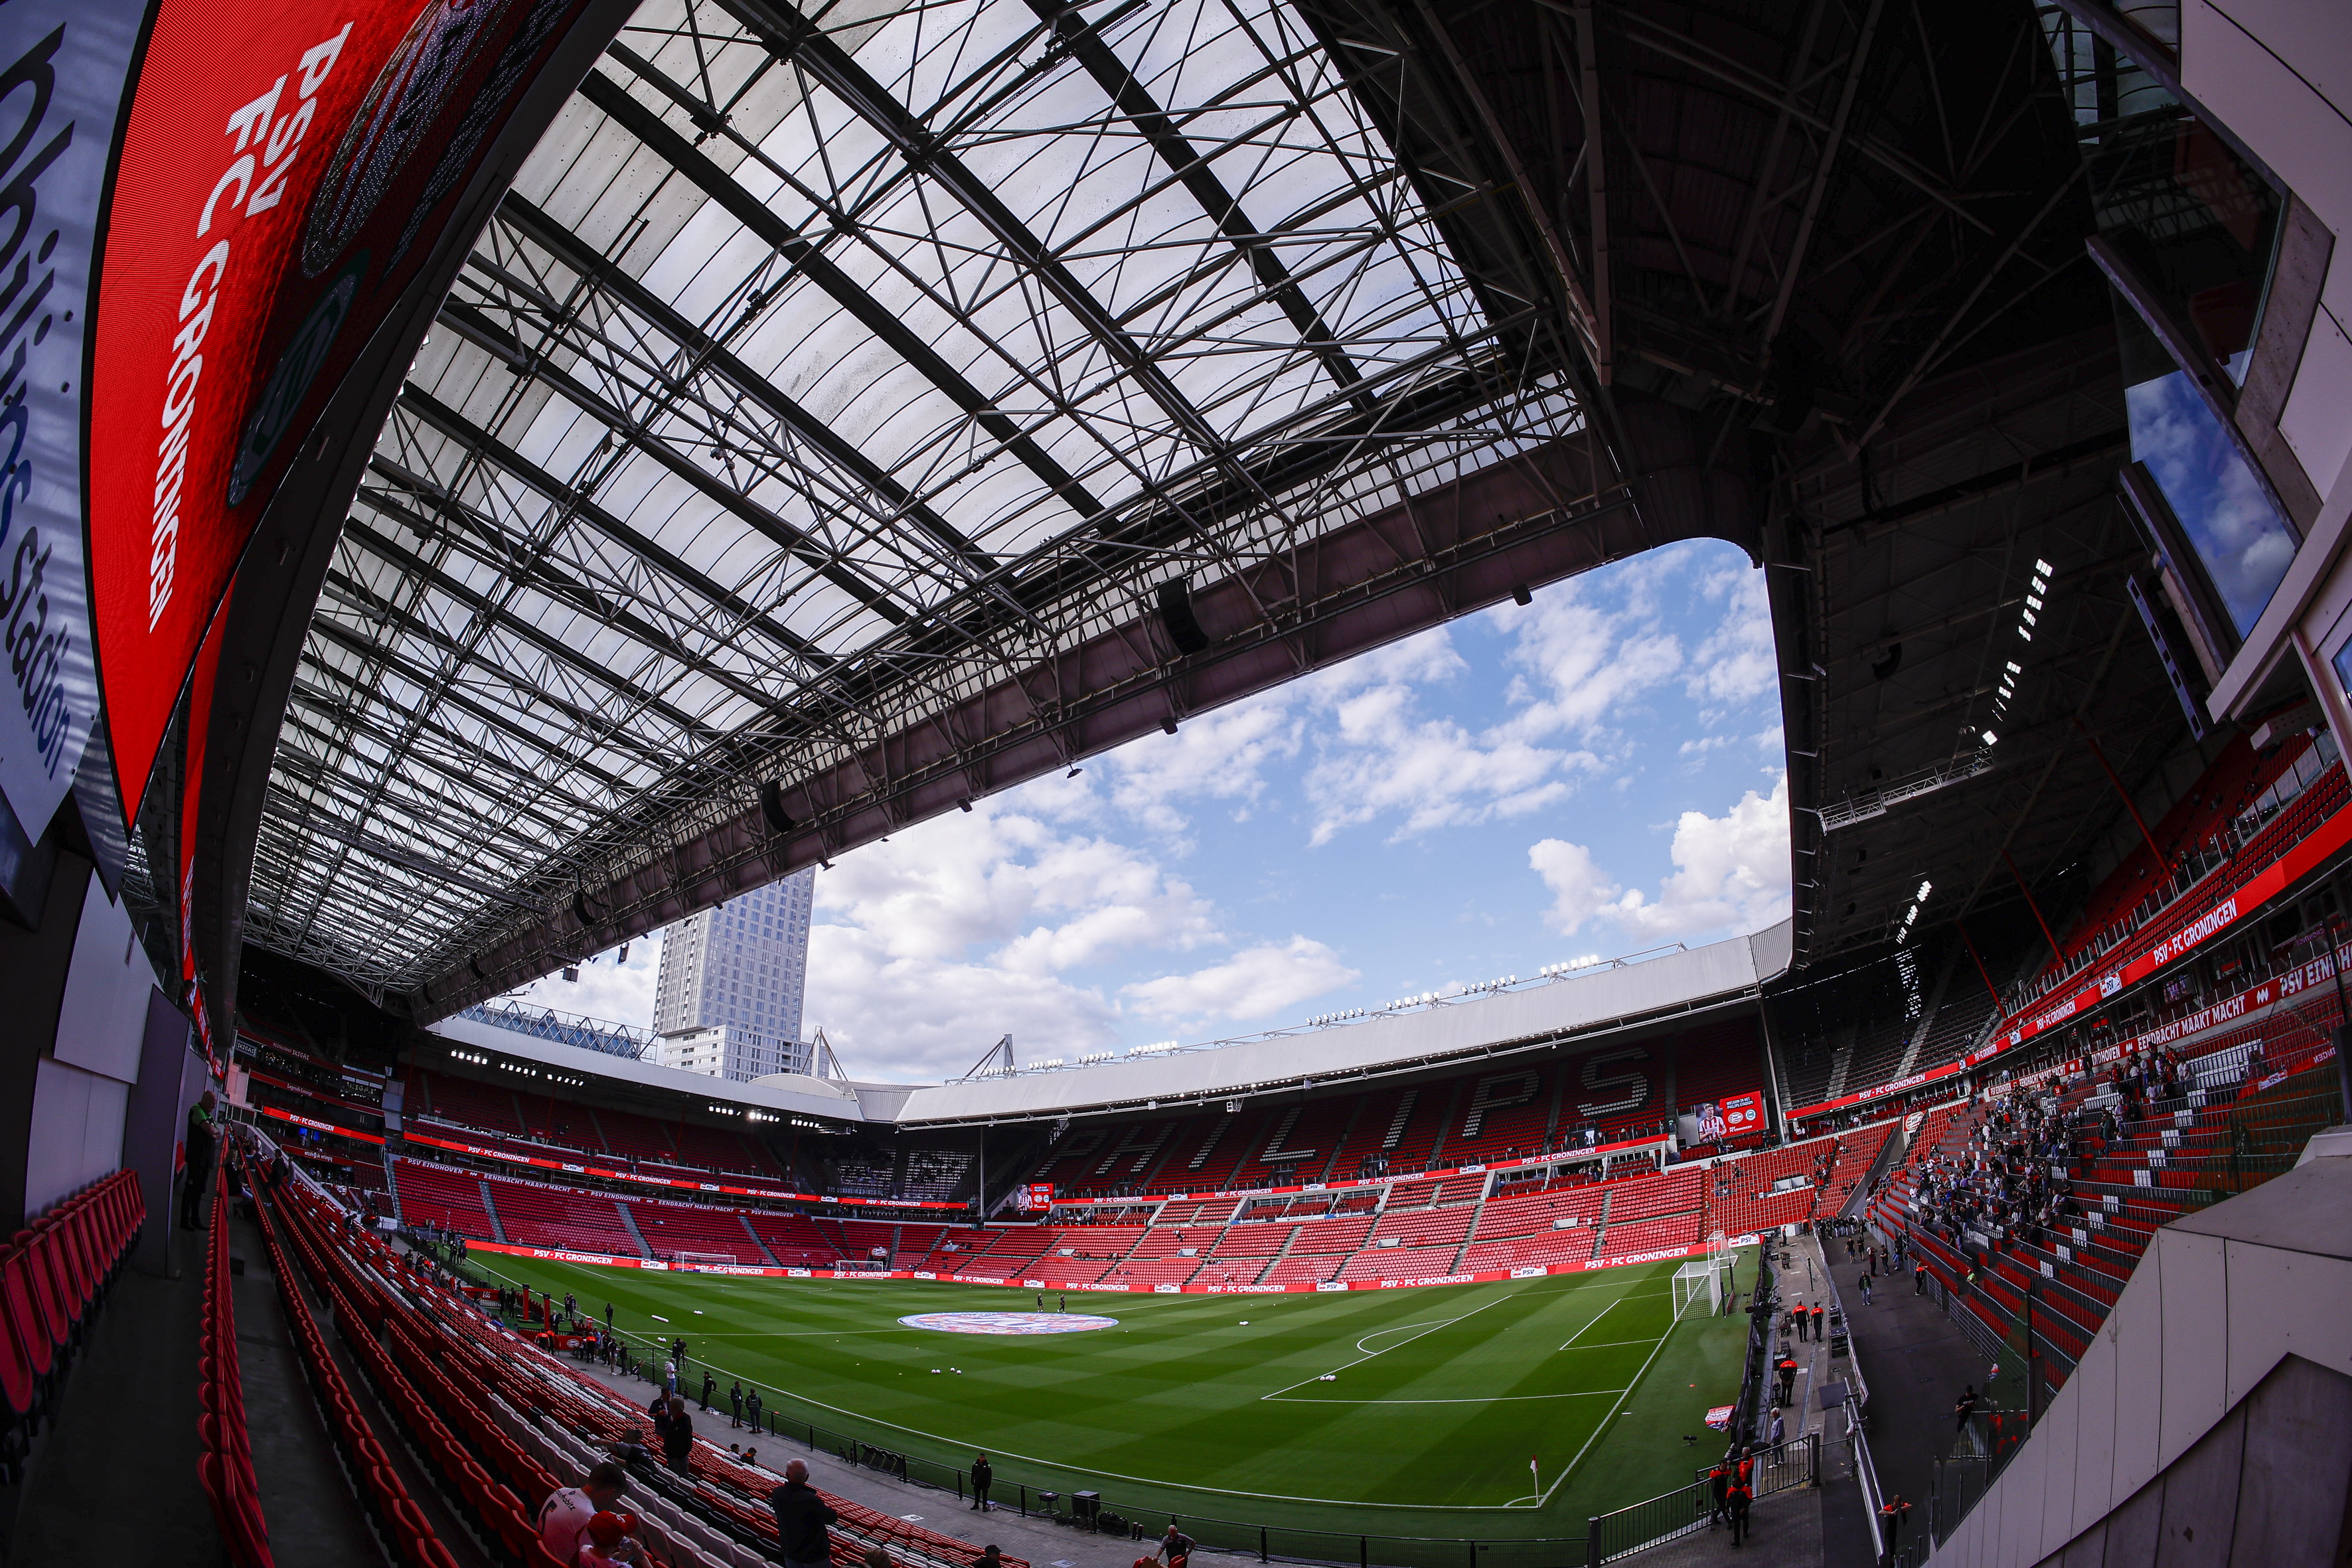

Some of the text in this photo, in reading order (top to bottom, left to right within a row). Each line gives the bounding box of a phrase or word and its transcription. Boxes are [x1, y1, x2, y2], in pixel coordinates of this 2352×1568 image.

[246, 20, 354, 218] PSV
[149, 73, 289, 633] FC GRONINGEN
[0, 526, 72, 781] stadion
[2153, 943, 2167, 966] PSV
[2171, 936, 2184, 955] FC
[2183, 898, 2237, 947] GRONINGEN
[2280, 969, 2302, 997] PSV
[2045, 1015, 2051, 1026] FC
[2051, 1000, 2076, 1022] GRONINGEN
[2137, 994, 2245, 1052] EENDRACHT MAAKT MACHT
[292, 1050, 309, 1060] IKIGAI
[2091, 1045, 2120, 1065] INDHOVEN
[2019, 1071, 2039, 1087] EENDRACHT
[287, 1083, 313, 1097] Legends Lounge
[1859, 1074, 1925, 1100] PSV FC GRONINGEN
[1996, 1082, 2011, 1094] EINDHOVEN
[1036, 1048, 1650, 1178] PHILIPS
[308, 1119, 335, 1131] GRONINGEN
[493, 1151, 530, 1163] GRONINGEN
[1551, 1147, 1596, 1160] GRONINGEN
[422, 1161, 463, 1174] EINDHOVEN
[483, 1174, 524, 1185] EENDRACHT
[524, 1180, 548, 1189] MAAKT
[638, 1176, 671, 1185] GRONINGEN
[1383, 1172, 1425, 1182] GRONINGEN
[604, 1193, 641, 1202] EINDHOVEN
[566, 1253, 613, 1265] GRONINGEN
[1585, 1259, 1605, 1269] PSV
[1611, 1256, 1625, 1266] FC
[1626, 1247, 1689, 1263] GRONINGEN
[1417, 1274, 1474, 1285] GRONINGEN
